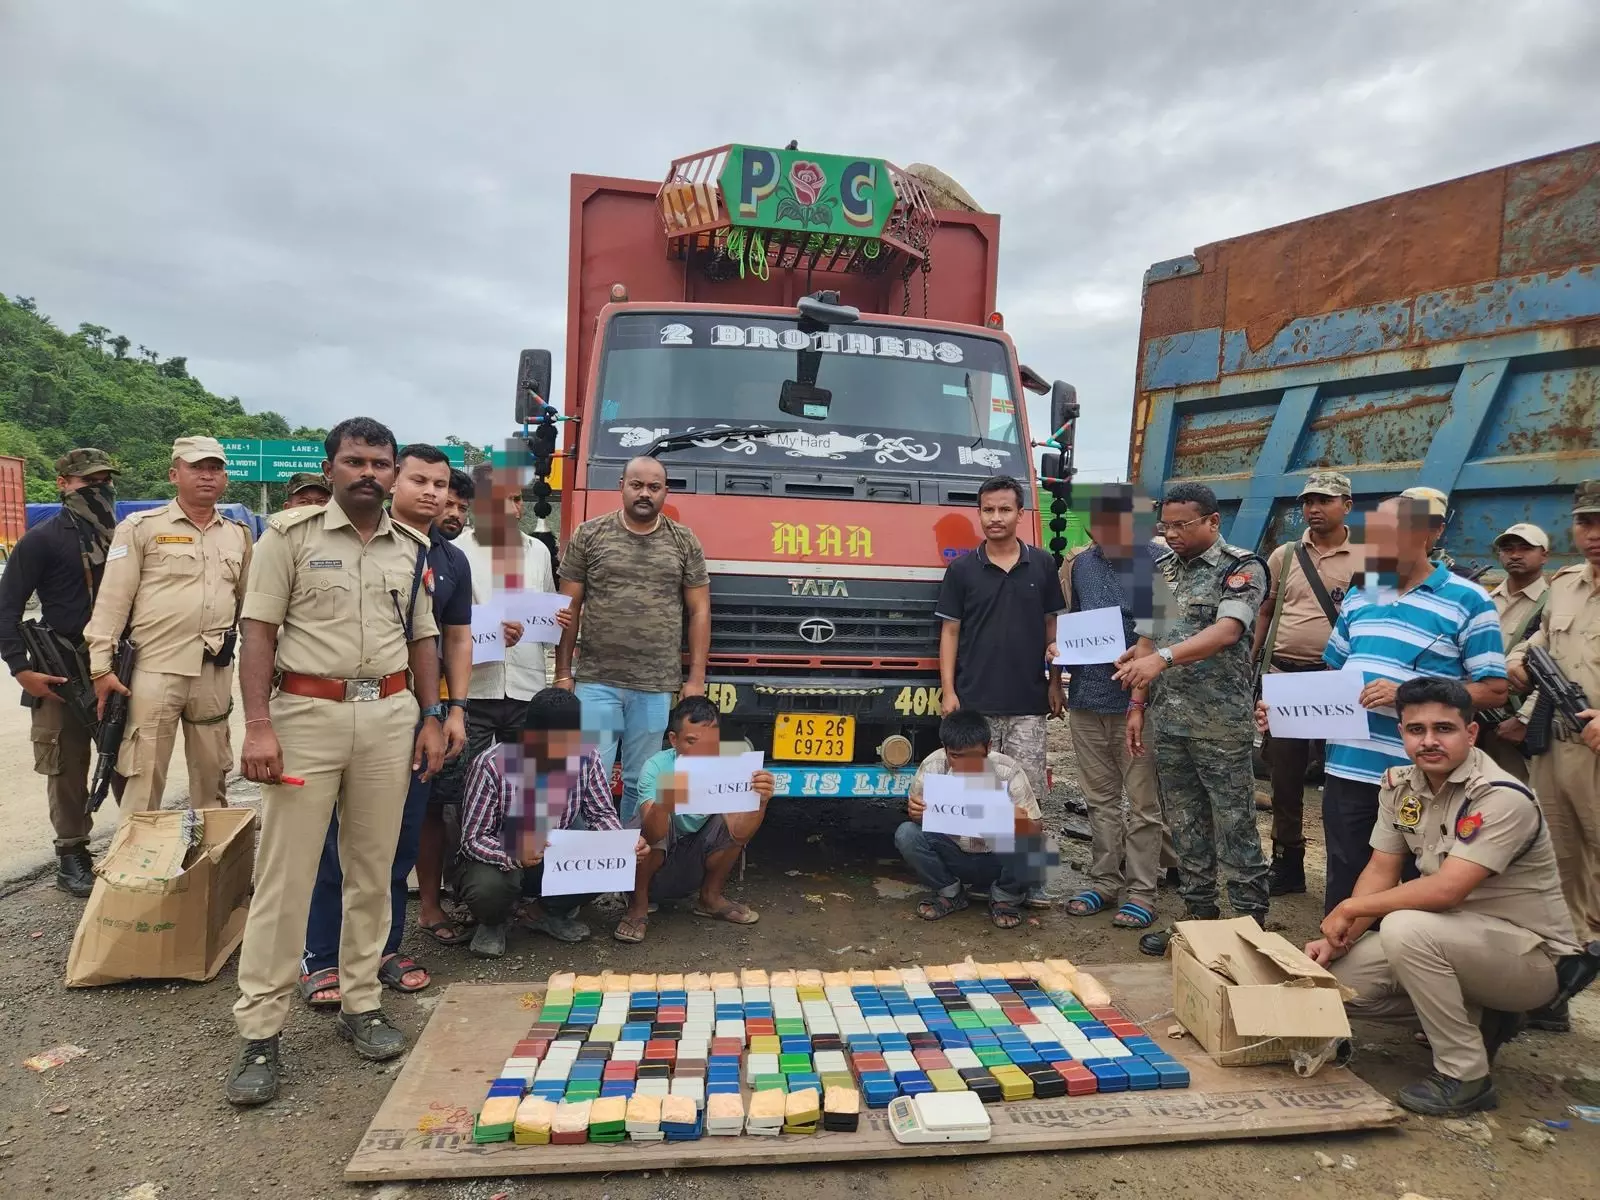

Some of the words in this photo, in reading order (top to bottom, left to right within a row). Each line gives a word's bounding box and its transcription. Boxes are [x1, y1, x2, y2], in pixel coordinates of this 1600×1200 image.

[739, 148, 781, 218] P
[840, 160, 877, 228] C
[660, 323, 693, 345] 2
[711, 324, 964, 364] BROTHERS
[777, 434, 796, 449] My
[801, 436, 831, 448] Hard
[272, 460, 297, 468] SINGLE
[788, 578, 849, 597] TATA
[1064, 635, 1116, 649] WITNESS
[1276, 704, 1355, 717] WITNESS
[795, 719, 815, 736] AS
[825, 720, 845, 737] 26
[794, 738, 844, 756] C9733
[801, 772, 842, 795] IS
[551, 857, 627, 873] ACCUSED
